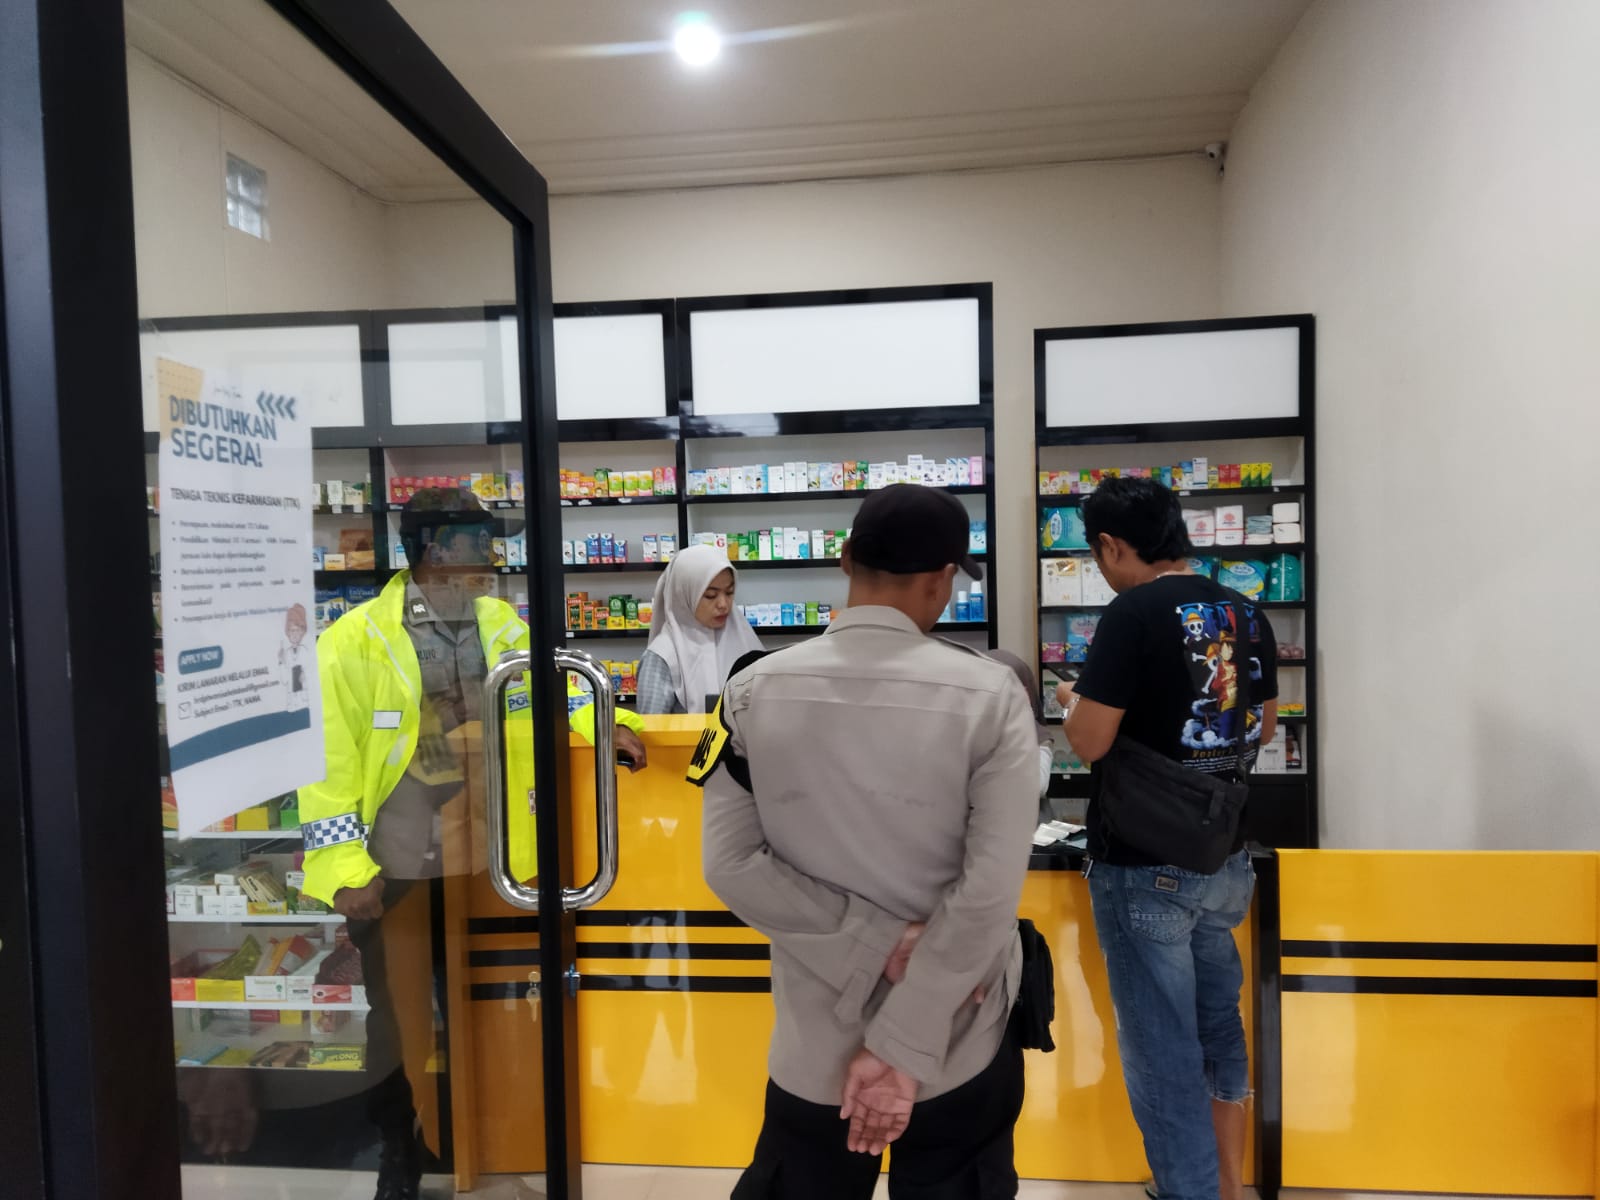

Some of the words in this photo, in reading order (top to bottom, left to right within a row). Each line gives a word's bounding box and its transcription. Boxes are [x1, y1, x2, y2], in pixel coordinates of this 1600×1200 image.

[170, 396, 277, 440] DIBUTUHKAN
[171, 428, 263, 468] SEGERA!
[170, 488, 201, 501] TENAGA
[202, 490, 231, 504] TEKNIS
